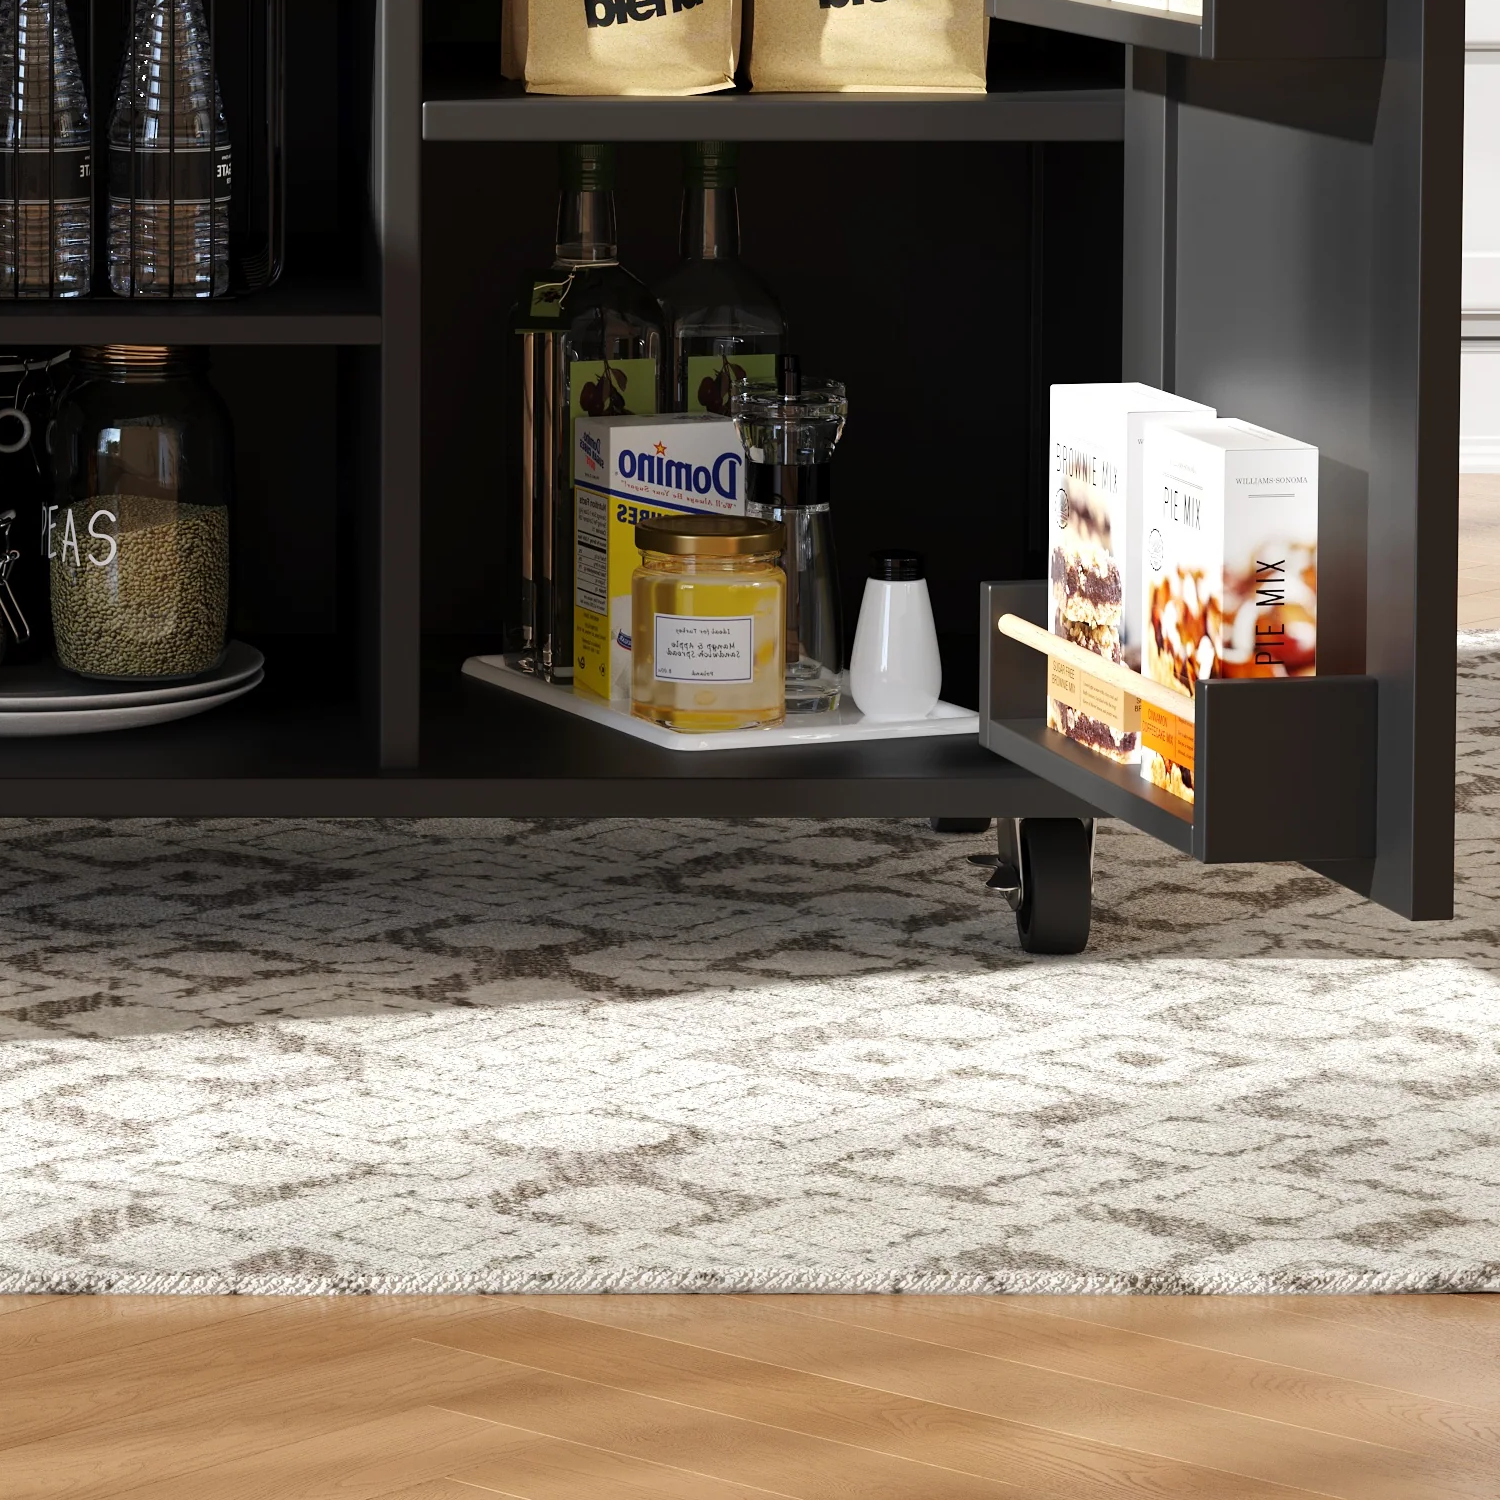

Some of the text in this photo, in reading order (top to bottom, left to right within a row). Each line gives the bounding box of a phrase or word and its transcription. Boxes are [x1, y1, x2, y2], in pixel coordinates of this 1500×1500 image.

[1056, 443, 1097, 486] BROWNIE
[1163, 486, 1201, 531] PIE MIX
[1255, 558, 1286, 666] PIE MIX
[1052, 660, 1066, 676] SUGAR
